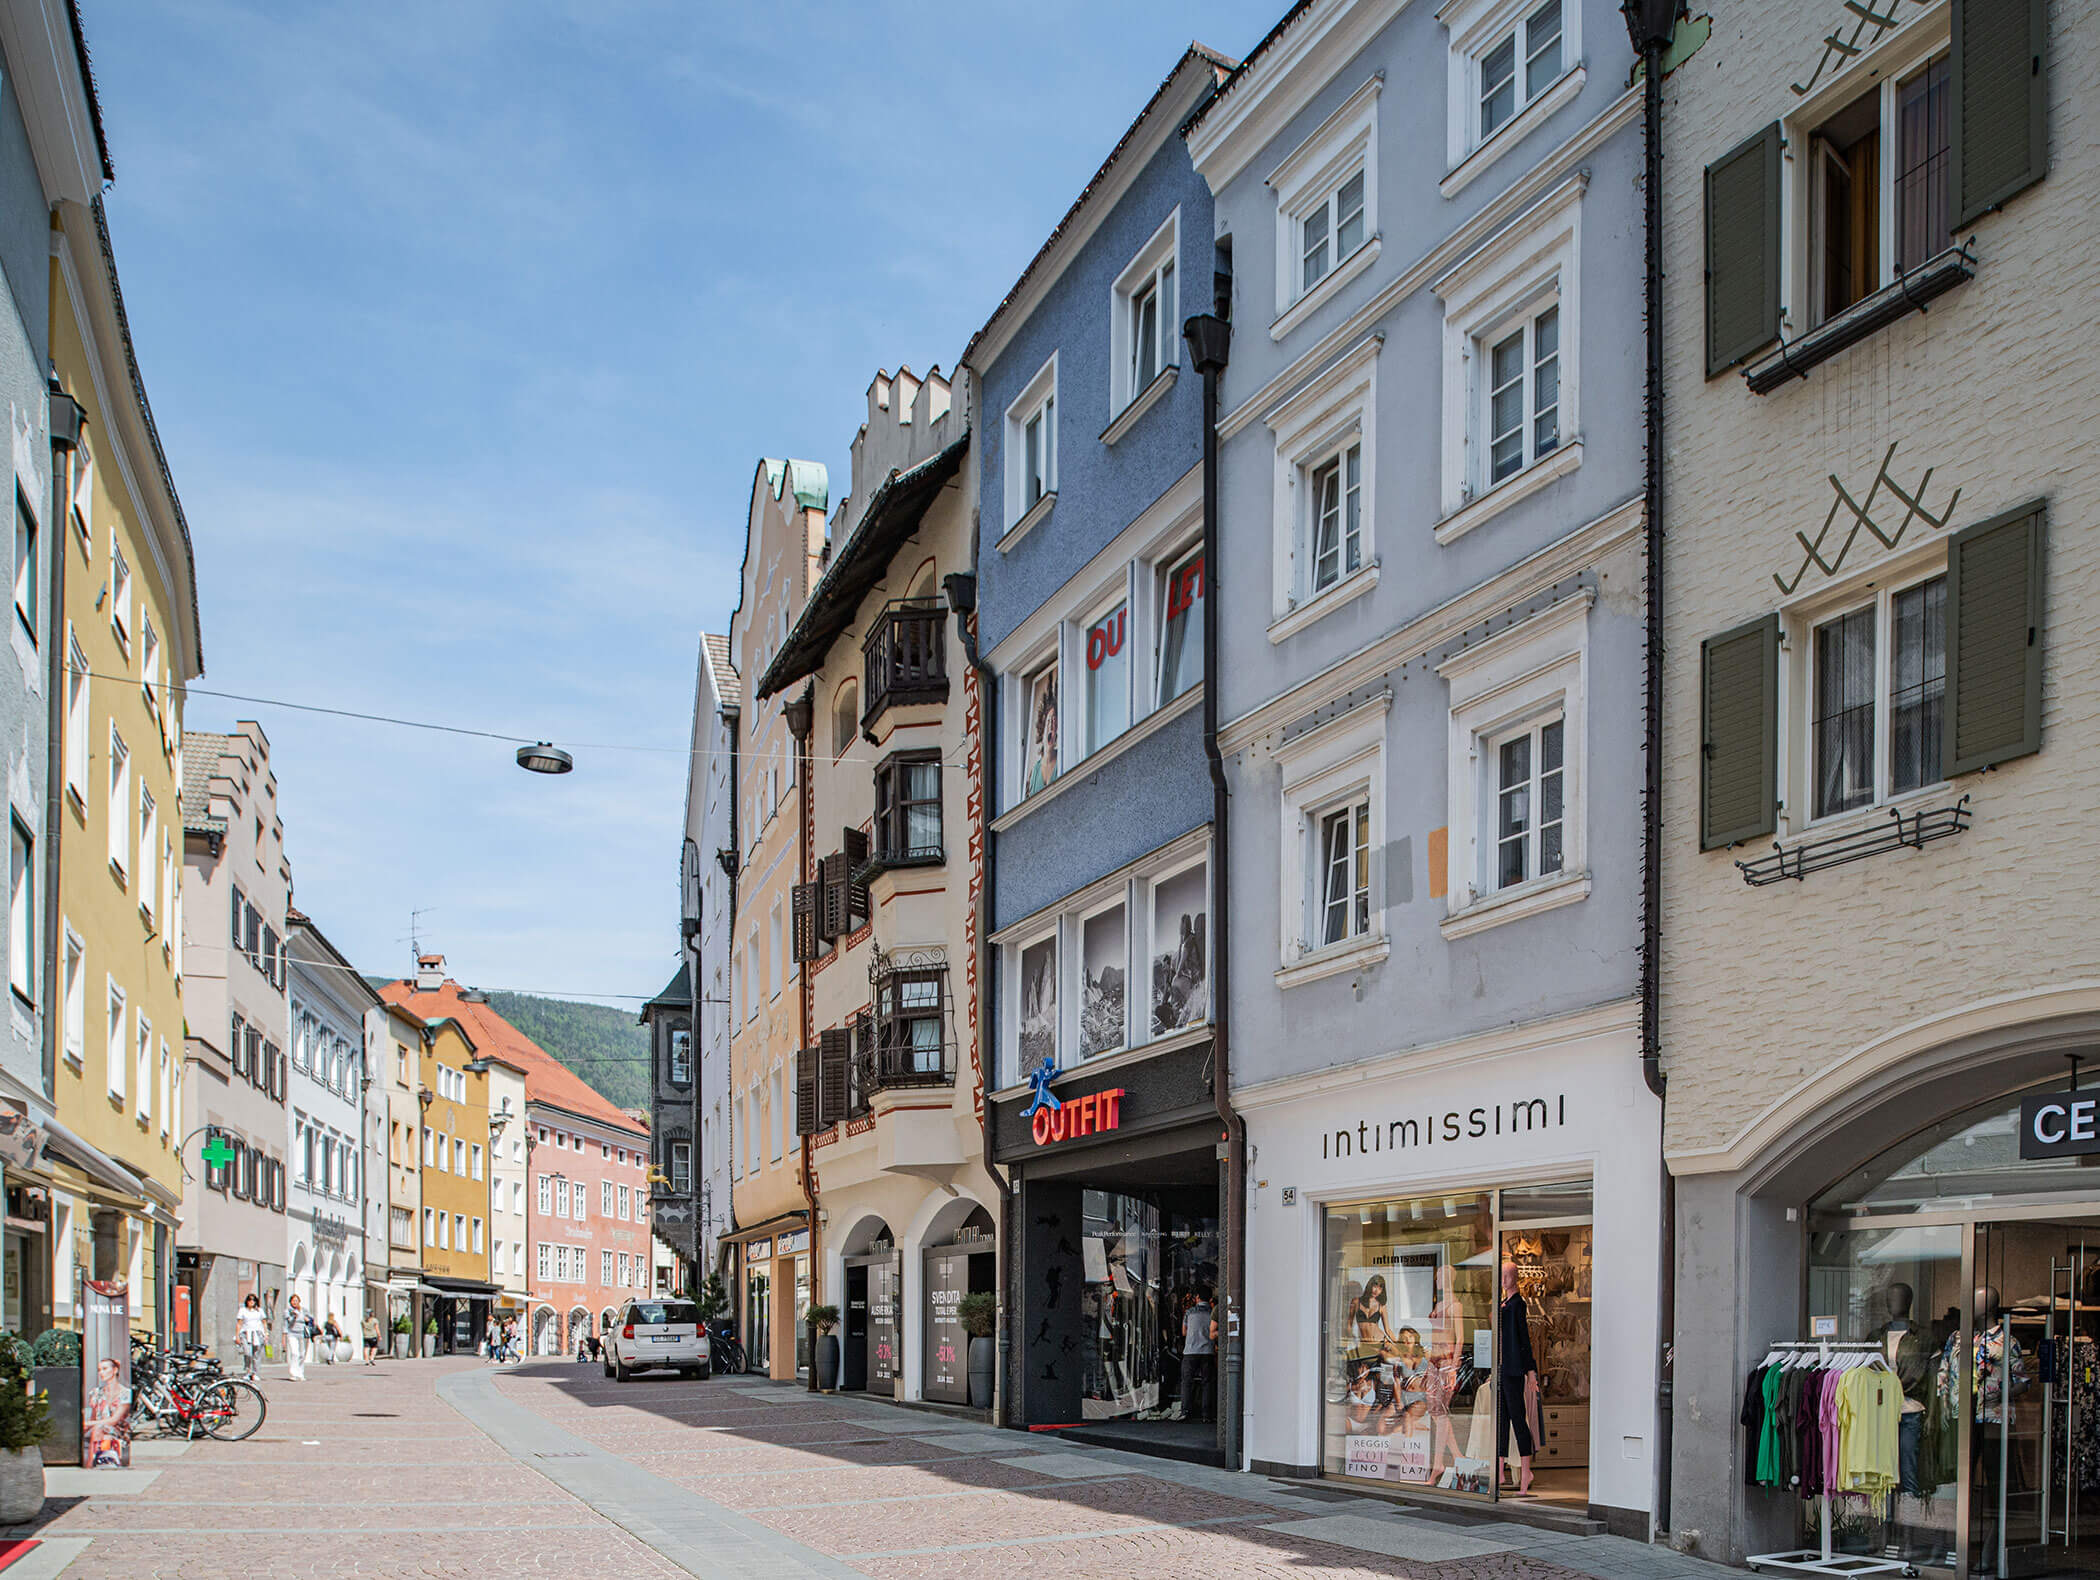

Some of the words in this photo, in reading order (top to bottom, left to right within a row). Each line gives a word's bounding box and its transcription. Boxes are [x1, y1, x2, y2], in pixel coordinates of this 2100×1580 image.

[1086, 607, 1127, 671] OU
[1032, 1088, 1125, 1146] OUTFIT
[1323, 1094, 1565, 1159] intimissimi
[2033, 1100, 2096, 1143] CE
[1284, 1190, 1293, 1200] 54
[931, 1291, 960, 1304] SVENDITA
[1348, 1463, 1378, 1473] FINO
